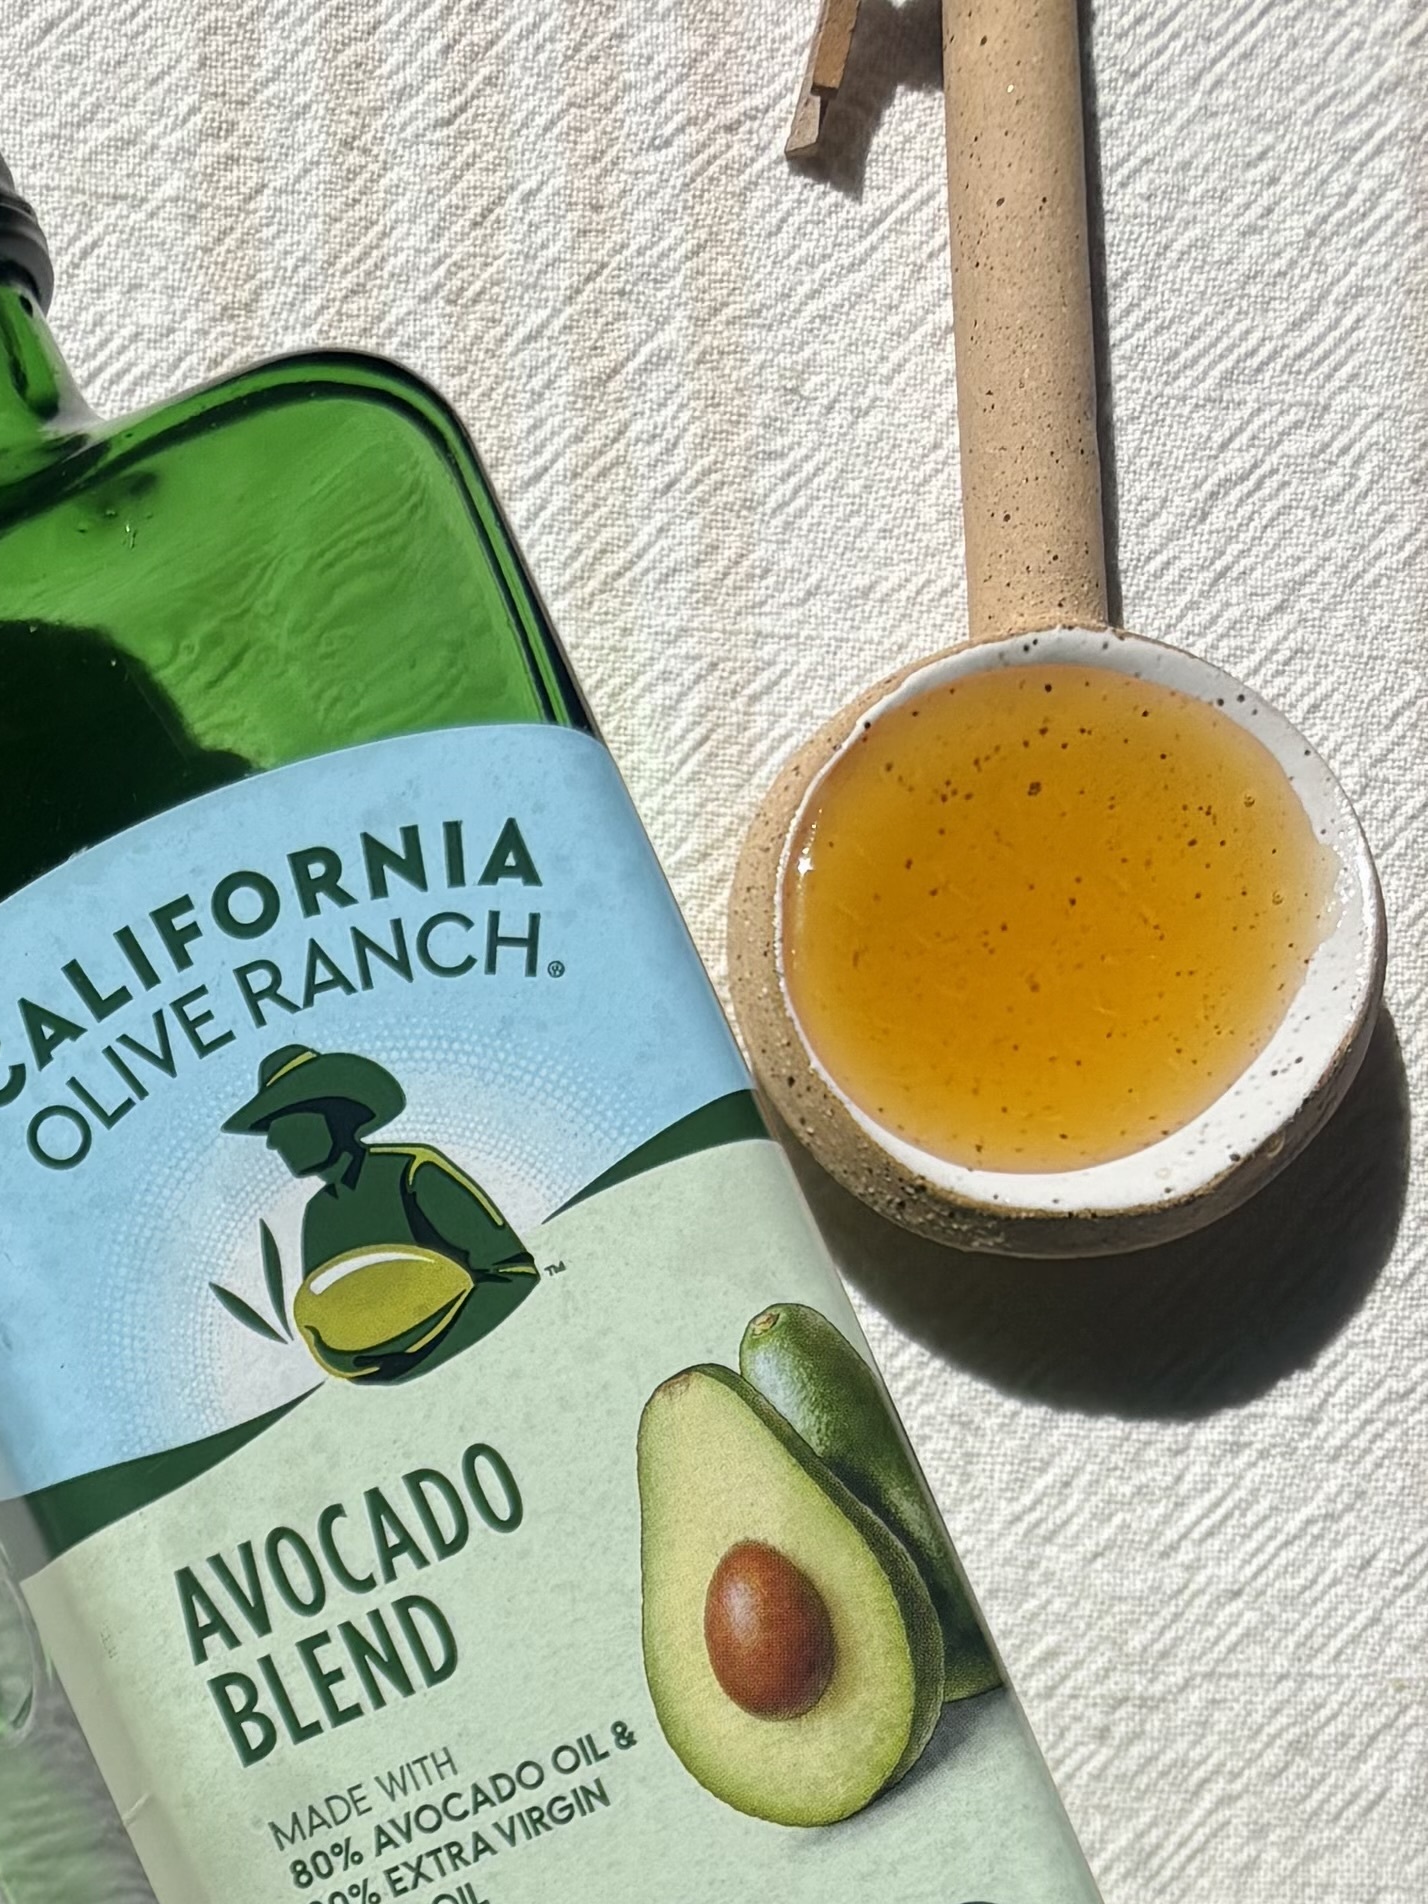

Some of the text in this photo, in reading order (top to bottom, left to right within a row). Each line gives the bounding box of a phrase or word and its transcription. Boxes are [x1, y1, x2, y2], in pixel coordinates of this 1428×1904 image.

[26, 985, 236, 1171] OLIVE
[173, 1442, 523, 1665] AVOCADO
[206, 1595, 457, 1768] BLEND
[268, 1746, 459, 1852] MADE WITH
[290, 1720, 637, 1889] 80% AVOCADO OIL &
[382, 1831, 498, 1898] EXTRA
[492, 1778, 612, 1848] VIRGIN
